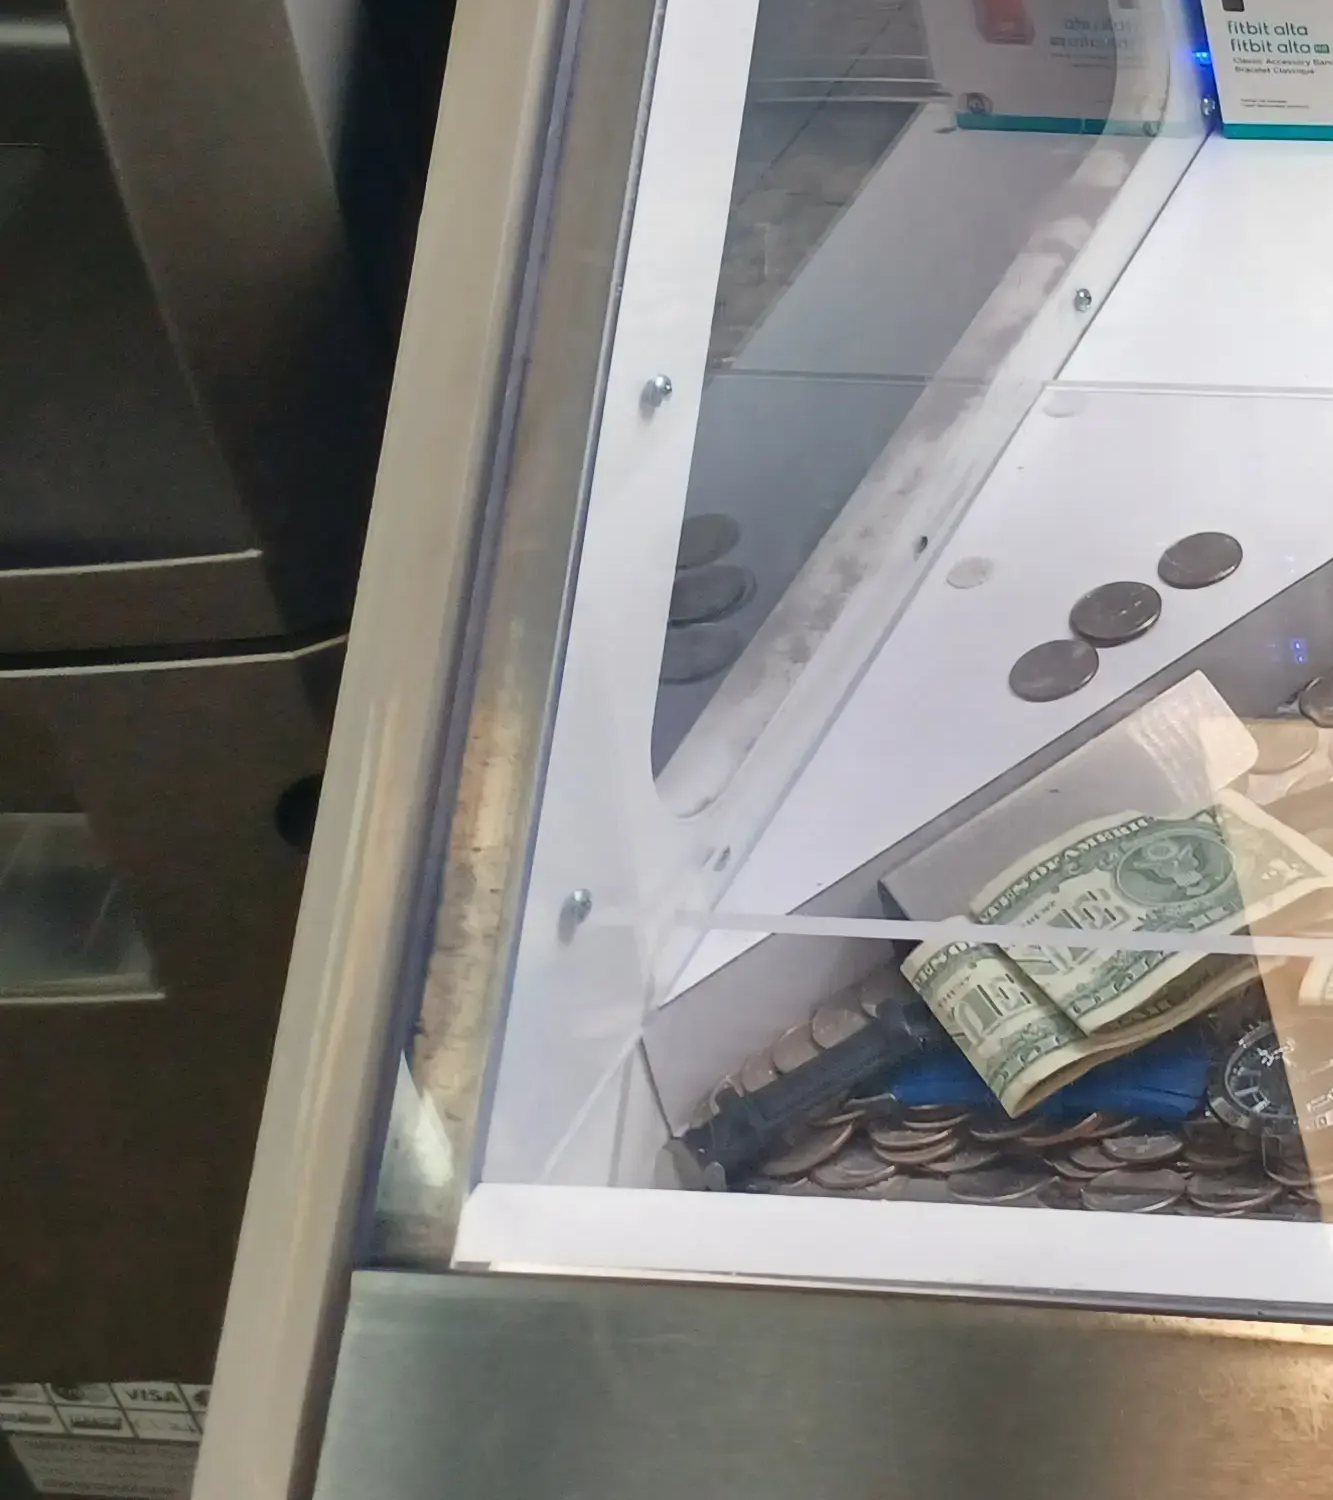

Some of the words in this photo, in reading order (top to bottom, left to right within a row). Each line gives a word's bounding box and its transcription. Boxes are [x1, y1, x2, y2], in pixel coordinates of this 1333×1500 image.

[1226, 19, 1270, 36] fitbit
[1273, 21, 1309, 37] alta
[1230, 37, 1274, 54] fitbit
[1276, 38, 1312, 55] alta
[124, 1387, 182, 1404] VISA
